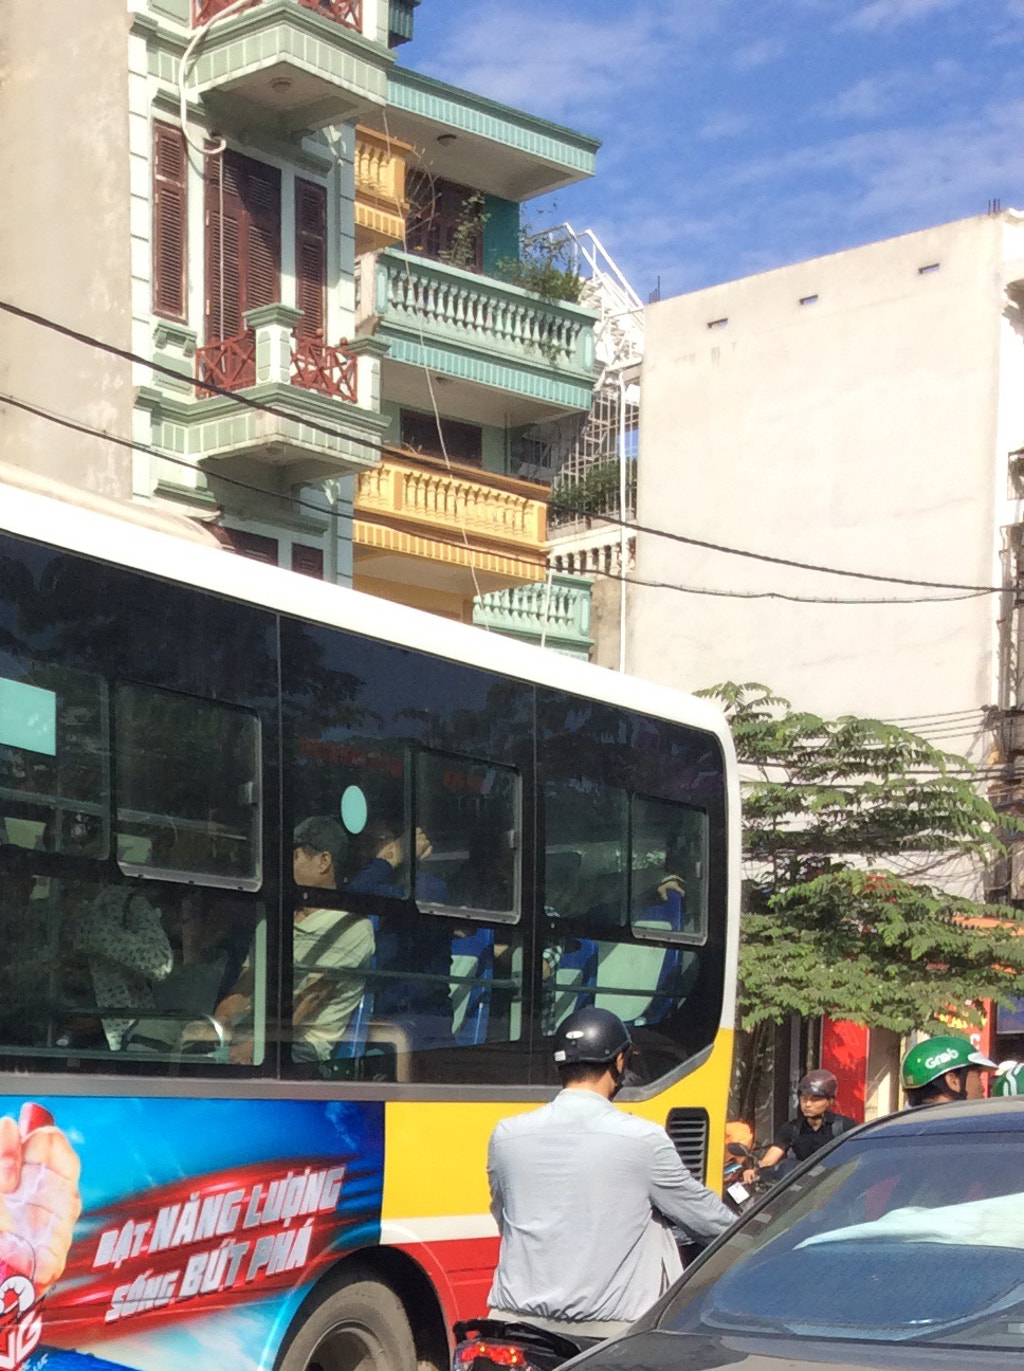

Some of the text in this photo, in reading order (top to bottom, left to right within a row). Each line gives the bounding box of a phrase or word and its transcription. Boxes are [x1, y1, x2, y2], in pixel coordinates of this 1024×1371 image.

[925, 1048, 959, 1069] Grab
[148, 1191, 245, 1253] NĂNG
[243, 1166, 346, 1229] LƯỢNG
[104, 1268, 180, 1323] SỐNG
[246, 1217, 315, 1283] PHÁ
